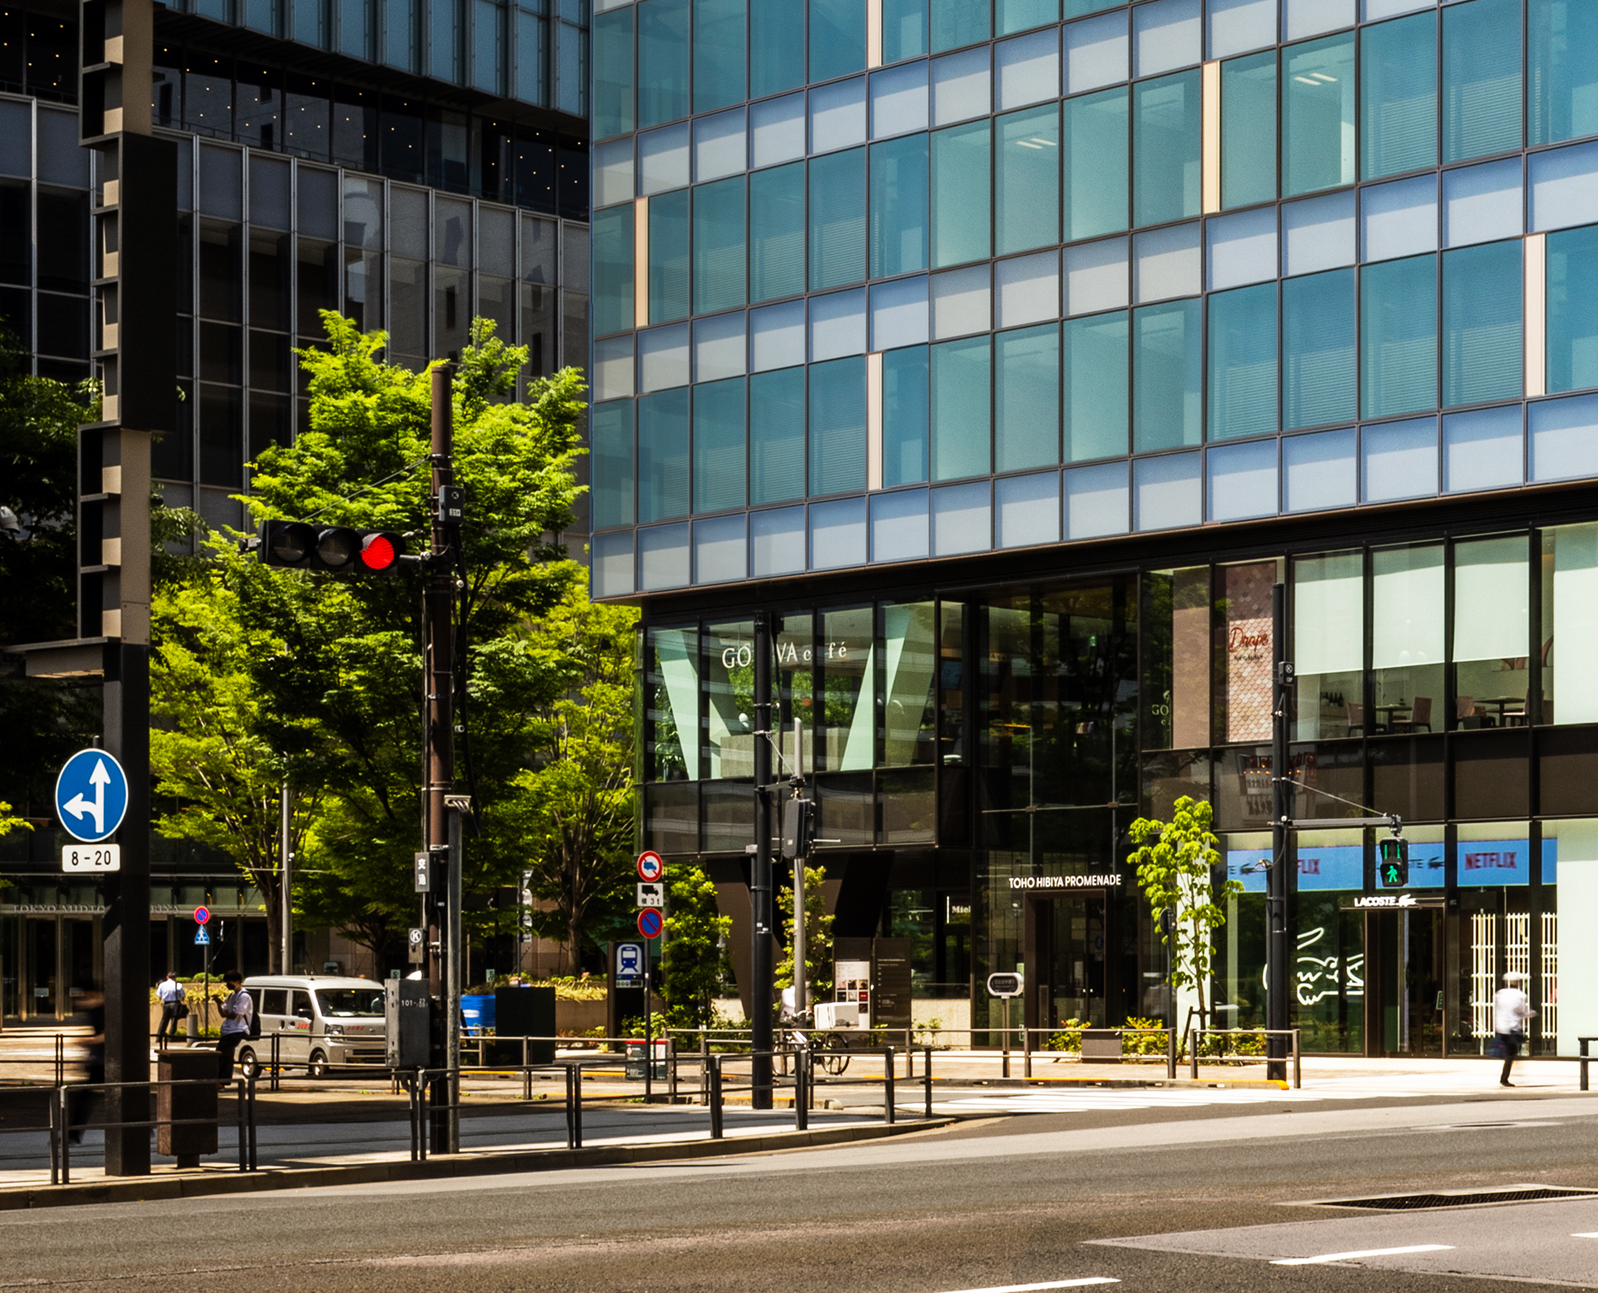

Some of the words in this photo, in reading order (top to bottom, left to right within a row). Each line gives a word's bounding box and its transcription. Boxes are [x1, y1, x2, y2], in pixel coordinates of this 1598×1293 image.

[1228, 626, 1269, 652] Drape
[721, 642, 798, 669] GOVA
[803, 641, 847, 661] cfé
[1297, 859, 1321, 875] FLIX
[1465, 851, 1517, 870] NETFLIX
[1009, 876, 1035, 889] TOHO
[1036, 875, 1064, 888] HIBIYA
[1064, 874, 1122, 887] PROMENADE
[12, 904, 56, 913] TOKYO
[61, 904, 106, 913] MIDTO
[1354, 896, 1396, 908] LACOSTE
